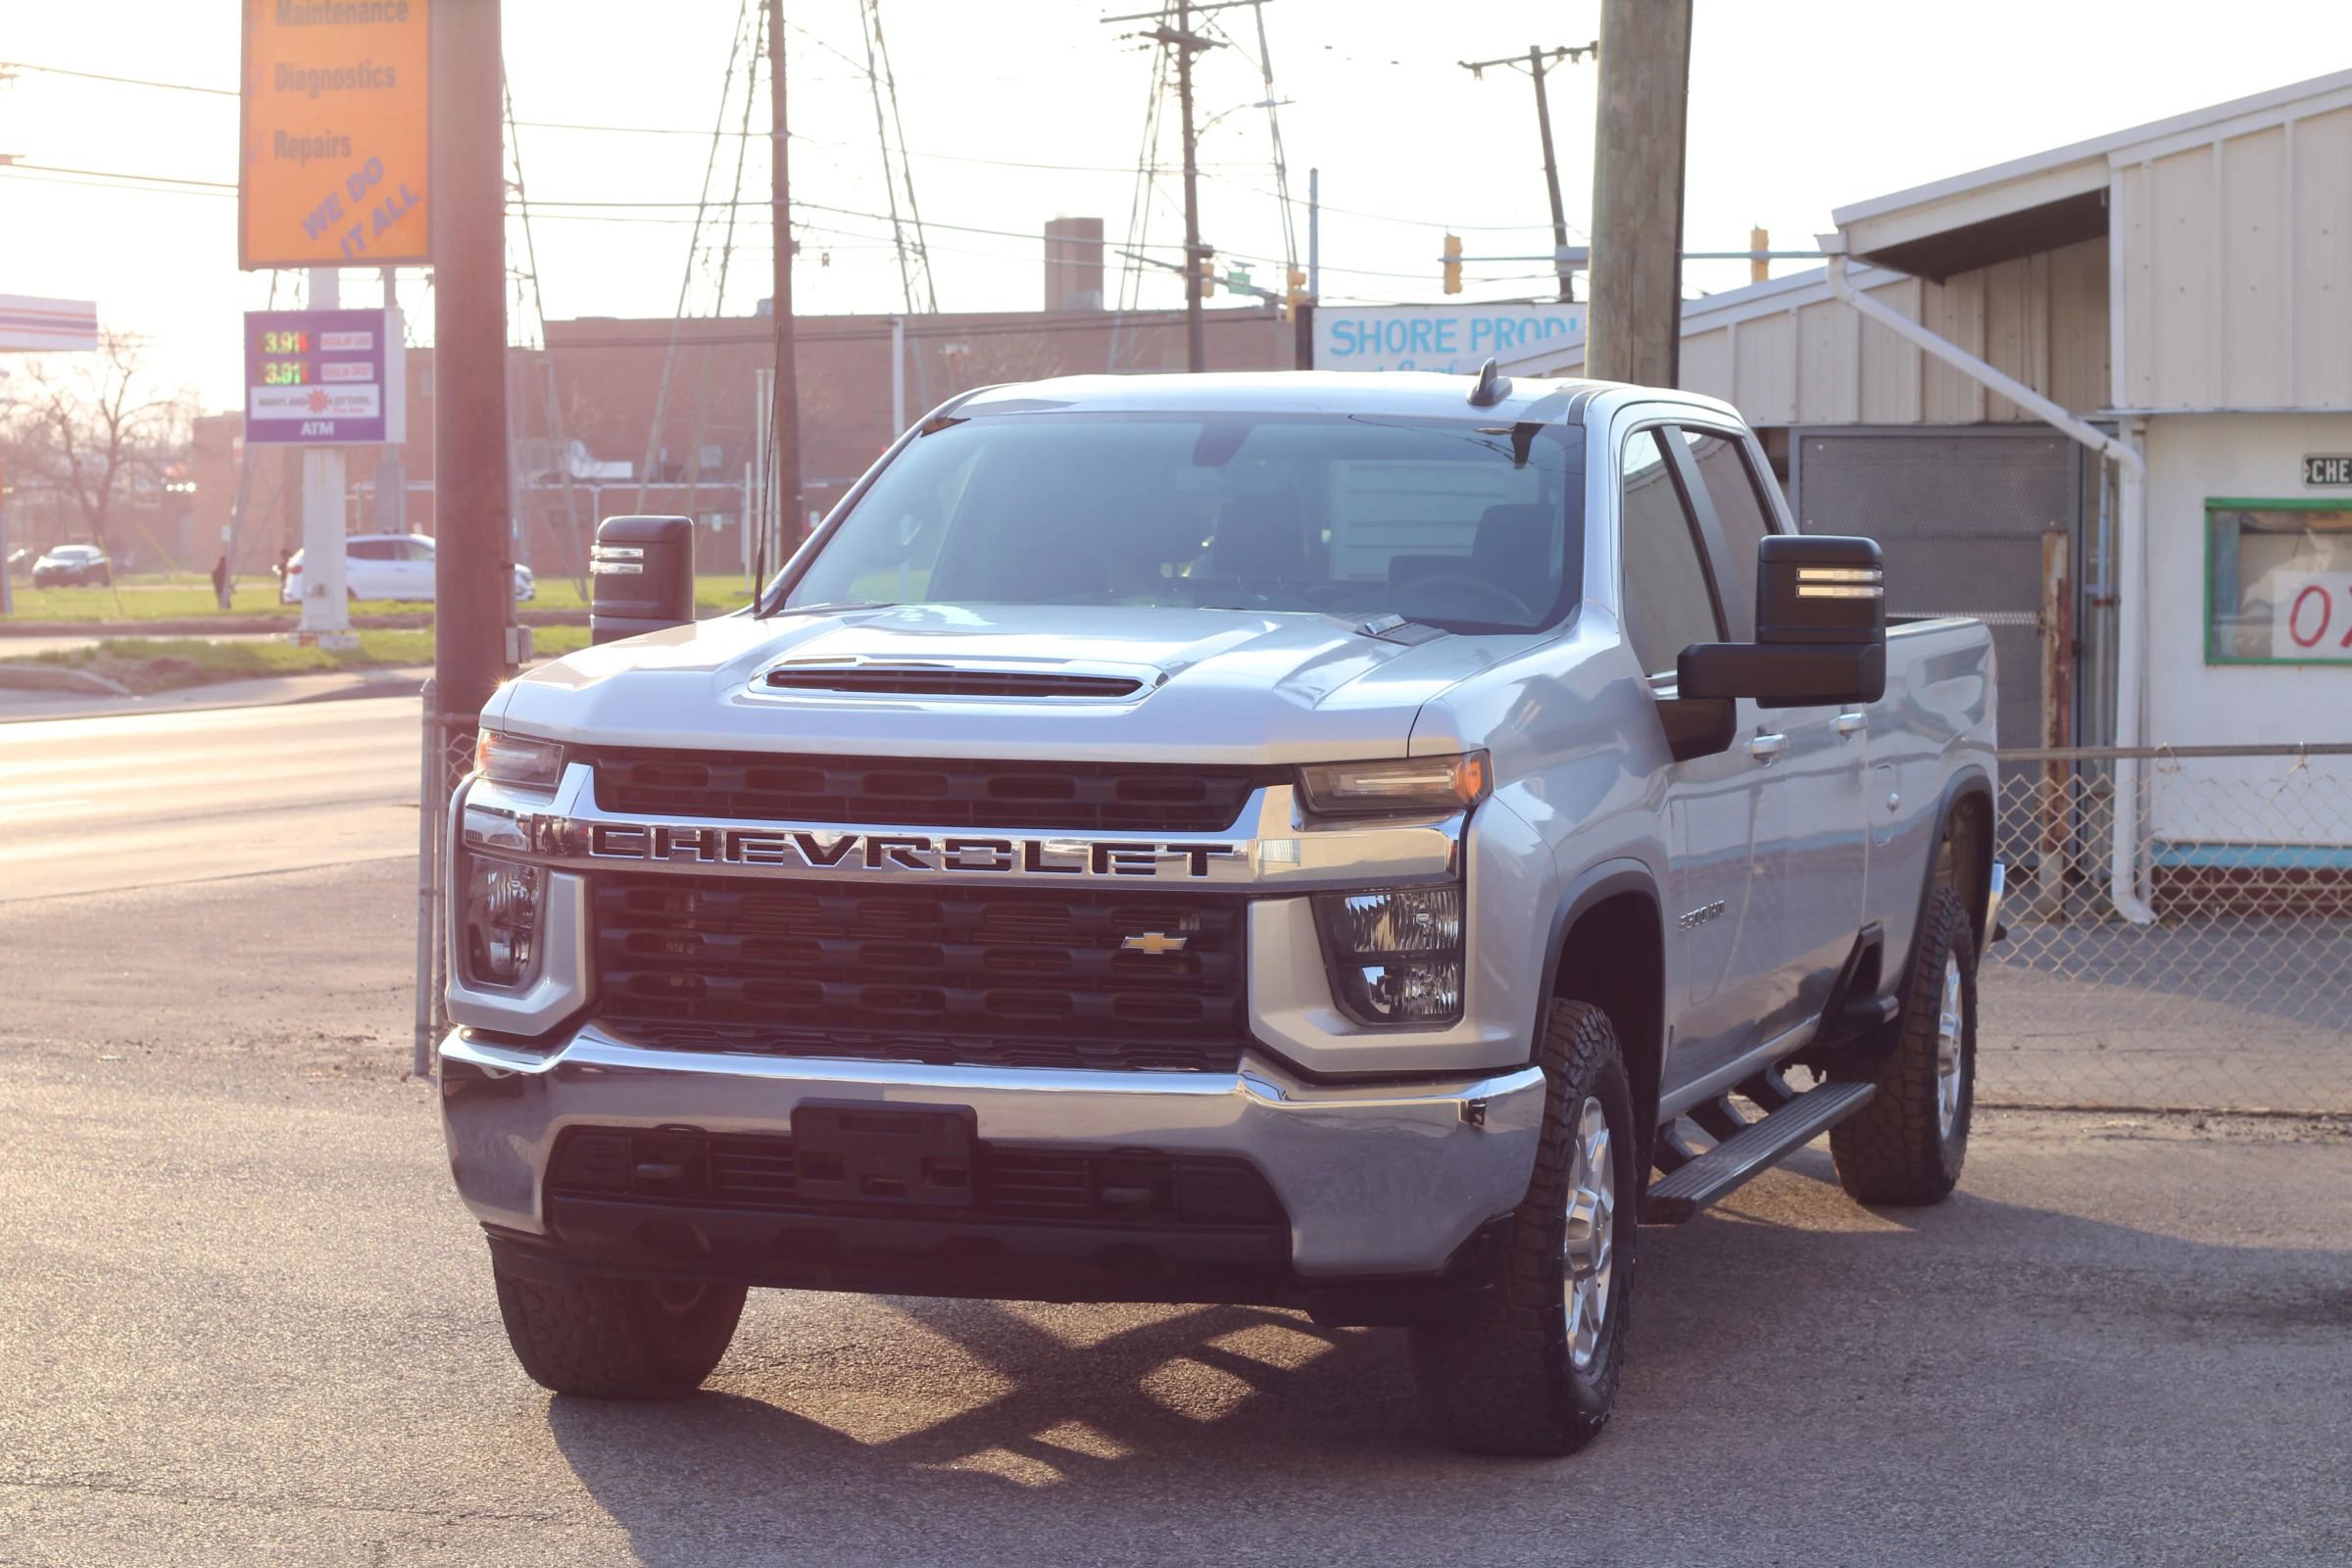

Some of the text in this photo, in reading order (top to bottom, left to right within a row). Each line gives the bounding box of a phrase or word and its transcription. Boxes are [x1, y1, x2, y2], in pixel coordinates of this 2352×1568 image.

[275, 0, 409, 27] Maintenance
[274, 60, 397, 100] Diagnostics
[273, 128, 352, 168] Repairs
[302, 156, 384, 241] WE DO
[340, 182, 419, 262] IT ALL
[1330, 318, 1458, 357] SHORE
[300, 420, 335, 437] ATM
[2311, 459, 2352, 483] CHE
[588, 823, 1235, 877] CHEVROLET
